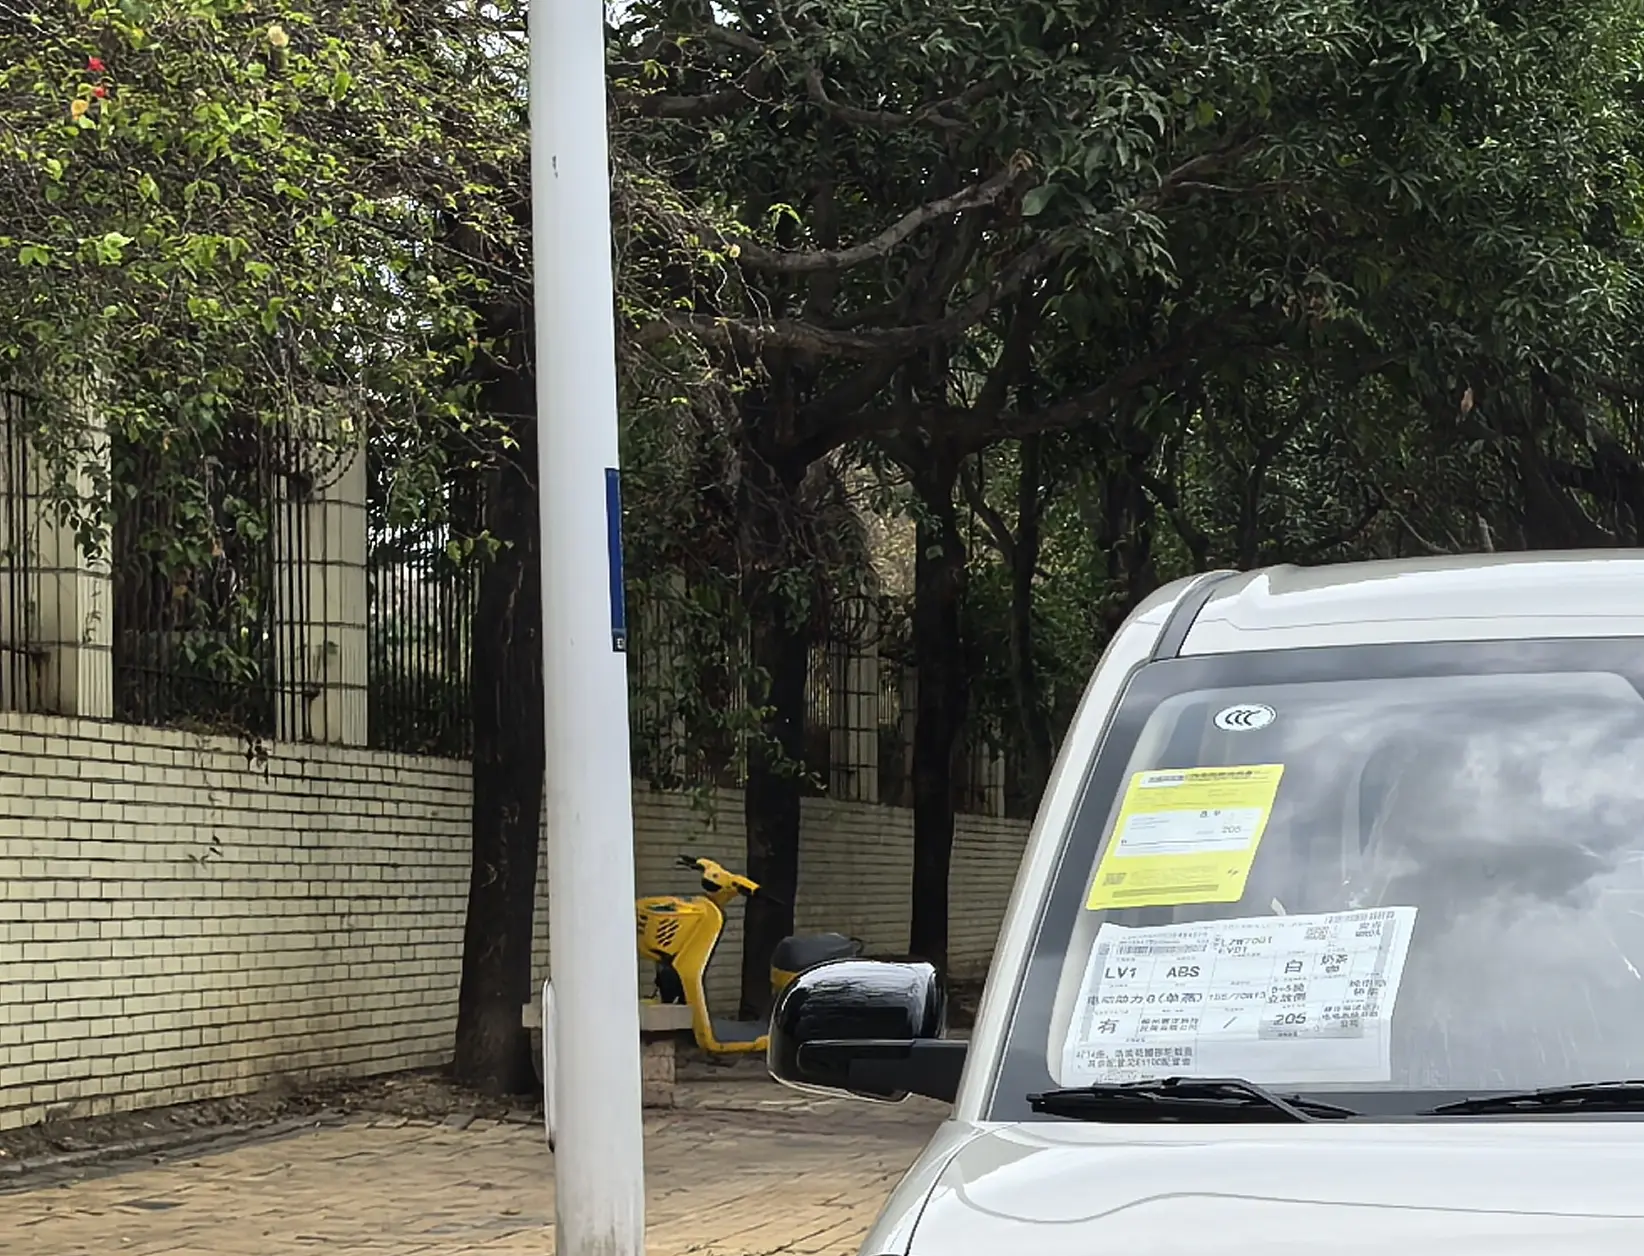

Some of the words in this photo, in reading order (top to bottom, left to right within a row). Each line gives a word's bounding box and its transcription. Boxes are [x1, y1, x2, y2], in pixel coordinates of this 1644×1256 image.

[1105, 967, 1137, 979] LV1
[1166, 966, 1201, 979] ABS
[1273, 1013, 1307, 1026] 205
